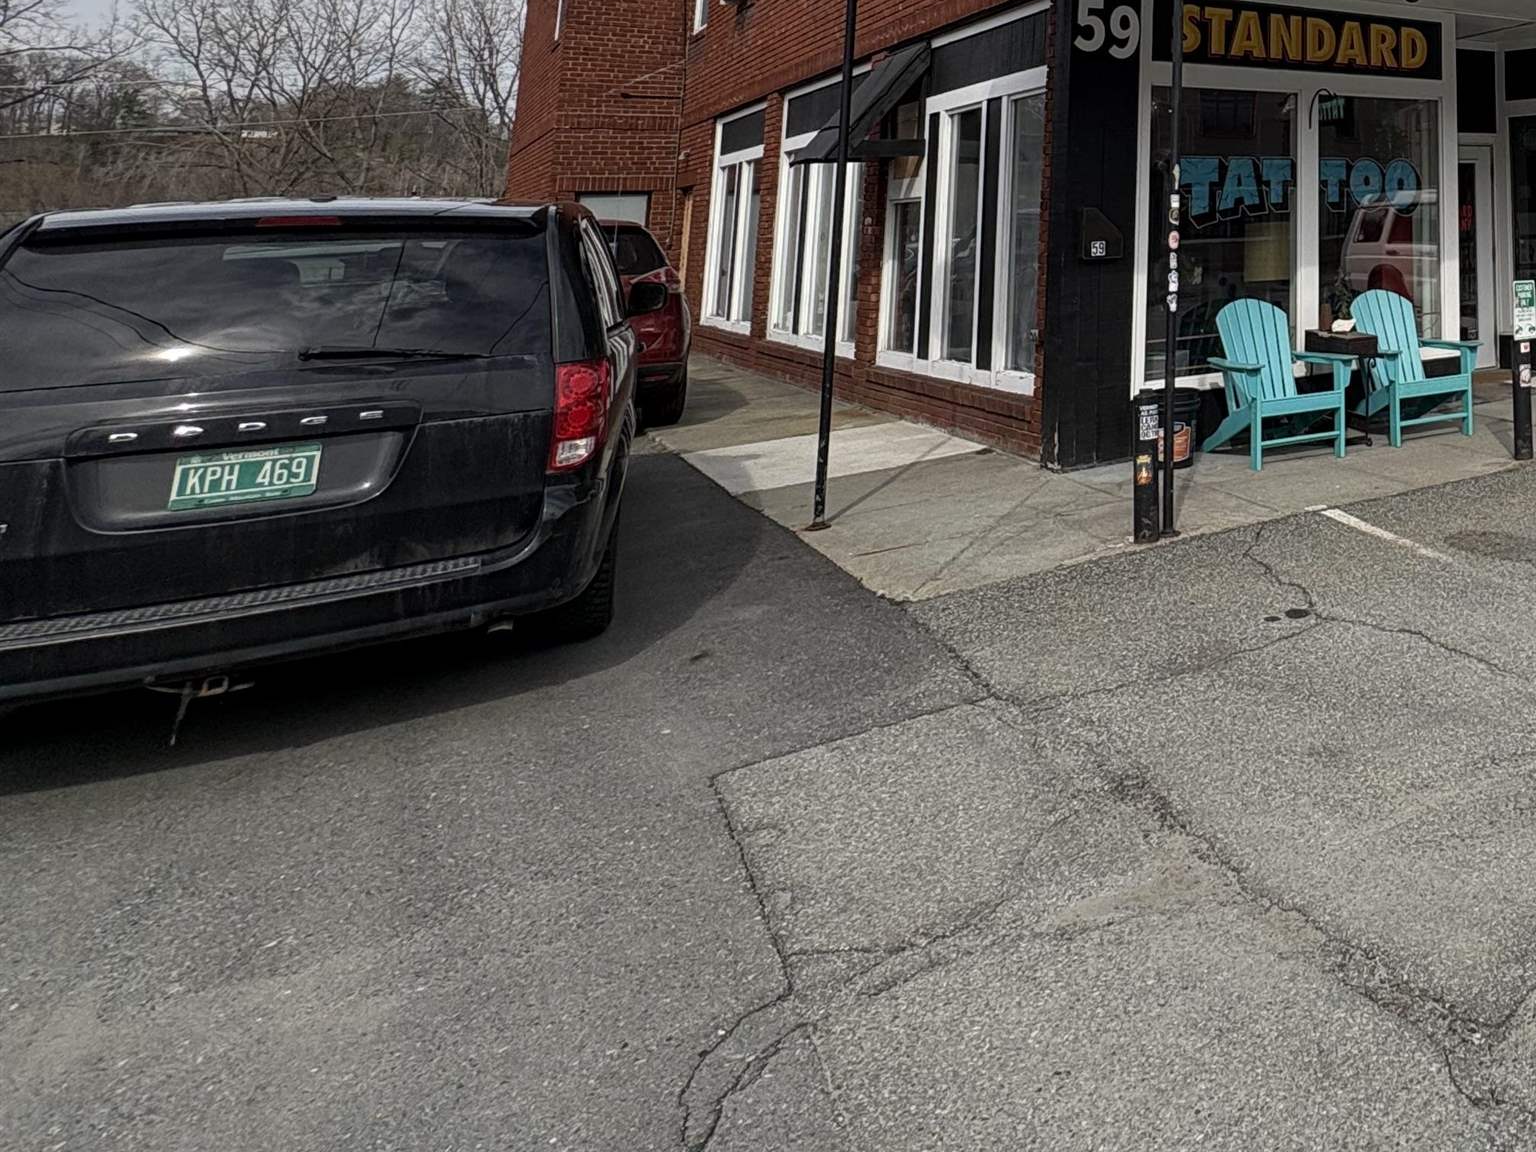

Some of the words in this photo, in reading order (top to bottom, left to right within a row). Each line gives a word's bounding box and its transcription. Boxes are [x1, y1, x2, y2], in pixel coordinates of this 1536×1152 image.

[1182, 3, 1429, 71] STANDARD
[1092, 242, 1106, 256] 59
[108, 410, 384, 442] DODGE
[185, 464, 241, 495] KPH
[255, 457, 308, 486] 469
